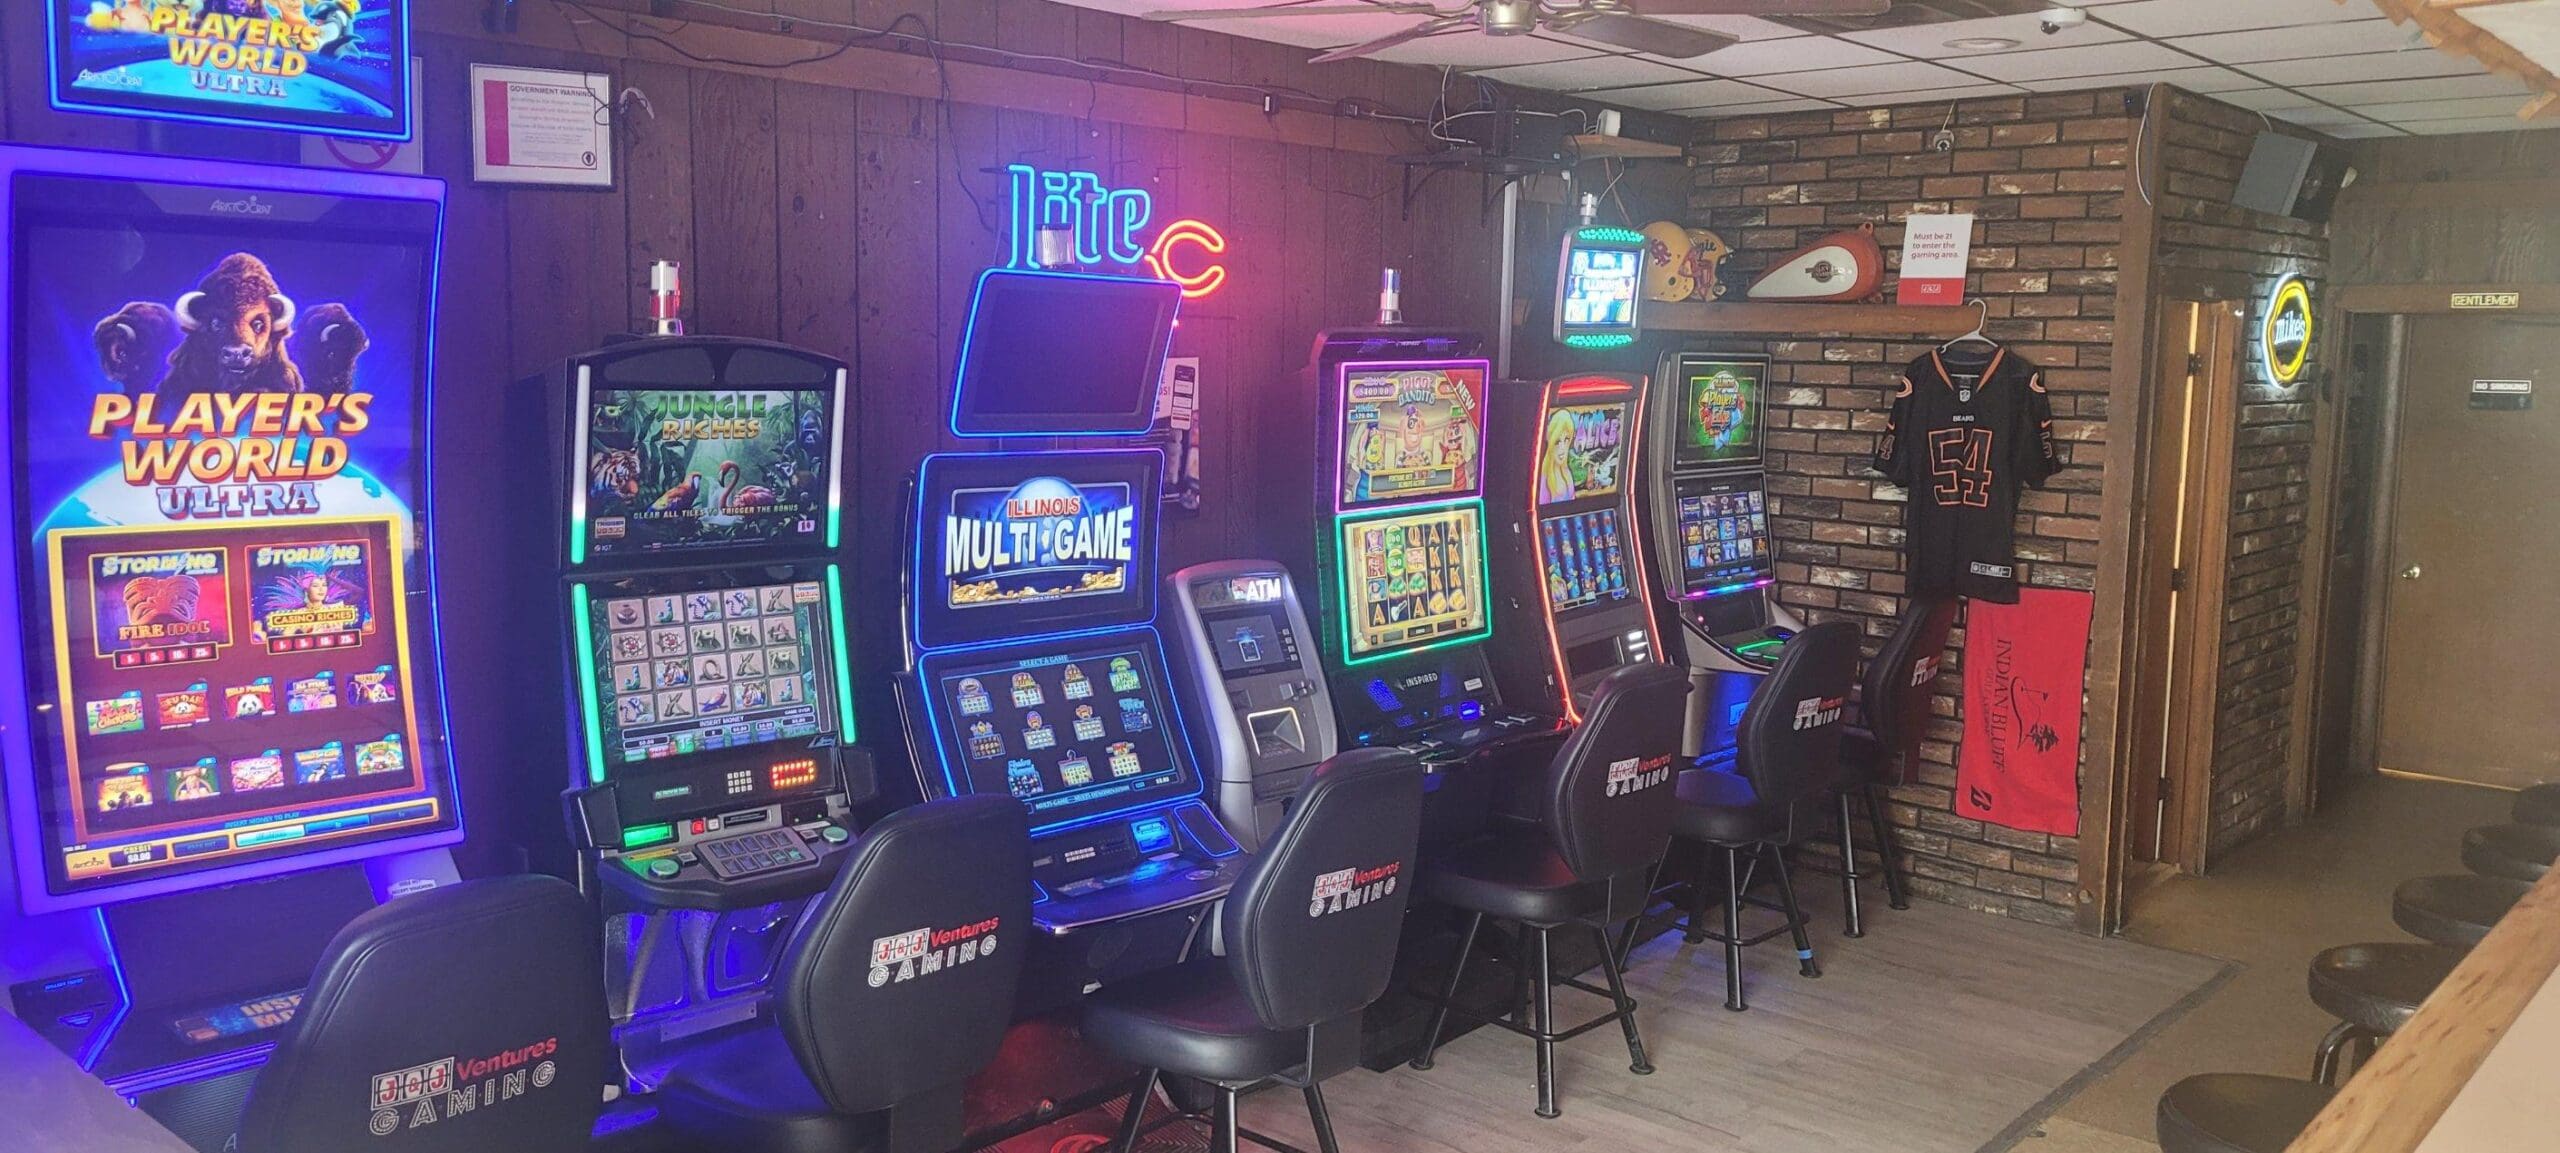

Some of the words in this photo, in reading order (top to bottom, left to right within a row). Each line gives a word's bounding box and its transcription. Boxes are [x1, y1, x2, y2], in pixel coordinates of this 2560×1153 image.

[150, 8, 322, 52] PLAYER'S
[168, 37, 307, 76] WORLD
[189, 69, 289, 98] ULTRA
[510, 85, 558, 95] GOVERNMENT
[560, 88, 593, 98] WARNING
[1914, 232, 1933, 240] Must
[1934, 232, 1943, 240] be
[1944, 232, 1952, 240] 21
[1911, 251, 1940, 259] gaming
[2454, 294, 2517, 306] GENTLEMEN
[1402, 375, 1434, 391] PIGGY
[1455, 378, 1476, 411] NEW
[2475, 382, 2488, 390] NO
[2490, 382, 2528, 391] SMOKING
[90, 391, 374, 438] PLAYER'S
[655, 393, 768, 421] JUNGLE
[1952, 414, 1974, 422] BEARS
[661, 418, 762, 441] RICHES
[1574, 417, 1620, 451] ALICE
[121, 436, 349, 486] WORLD
[1928, 427, 1993, 508] 54
[156, 483, 320, 520] ULTRA
[633, 509, 661, 520] CLEAR
[662, 508, 680, 518] ALL
[681, 507, 704, 517] TILES
[721, 505, 755, 515] TRIGGER
[756, 505, 772, 514] THE
[773, 503, 799, 513] BONUS
[1007, 496, 1081, 518] ILLINOIS
[945, 515, 1038, 576] MULTI
[1053, 505, 1134, 561] GAME
[1246, 578, 1282, 600] ATM
[119, 624, 165, 641] FIRE
[166, 619, 212, 636] IDOL
[273, 612, 316, 626] CASINO
[316, 608, 354, 622] RICHES
[1405, 672, 1438, 688] INSPIRED
[1994, 638, 2012, 710] INDIAN
[700, 718, 721, 727] INSERT
[722, 715, 744, 725] MONEY
[1990, 711, 2008, 774] BLUFF
[1605, 765, 1669, 797] GAMING
[249, 815, 274, 825] MONEY
[284, 811, 300, 819] PLAY
[123, 844, 152, 855] CREDIT
[127, 852, 151, 864] $0.00
[1355, 861, 1400, 885] Ventures
[1309, 876, 1396, 918] GAMING
[874, 930, 927, 964] J&J
[930, 917, 999, 947] Ventures
[868, 934, 997, 988] GAMING
[376, 1060, 452, 1107] J&J
[457, 1037, 558, 1081] Ventures
[369, 1060, 556, 1136] GAMING
